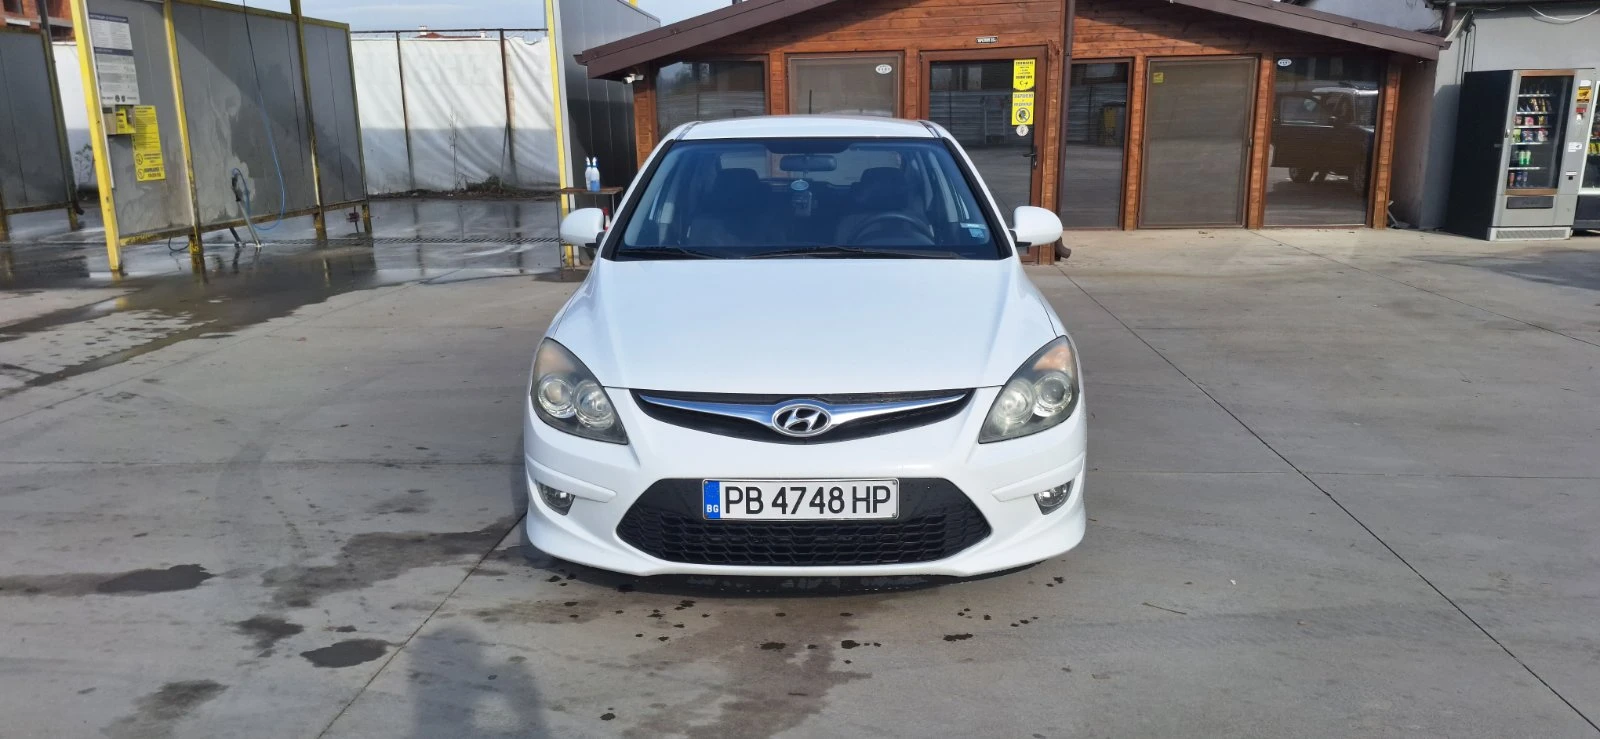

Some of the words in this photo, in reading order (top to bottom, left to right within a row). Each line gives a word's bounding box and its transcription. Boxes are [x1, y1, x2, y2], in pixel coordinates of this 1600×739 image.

[706, 504, 719, 513] BG
[725, 486, 764, 514] PB
[771, 486, 845, 514] 4748
[852, 485, 891, 514] HP
